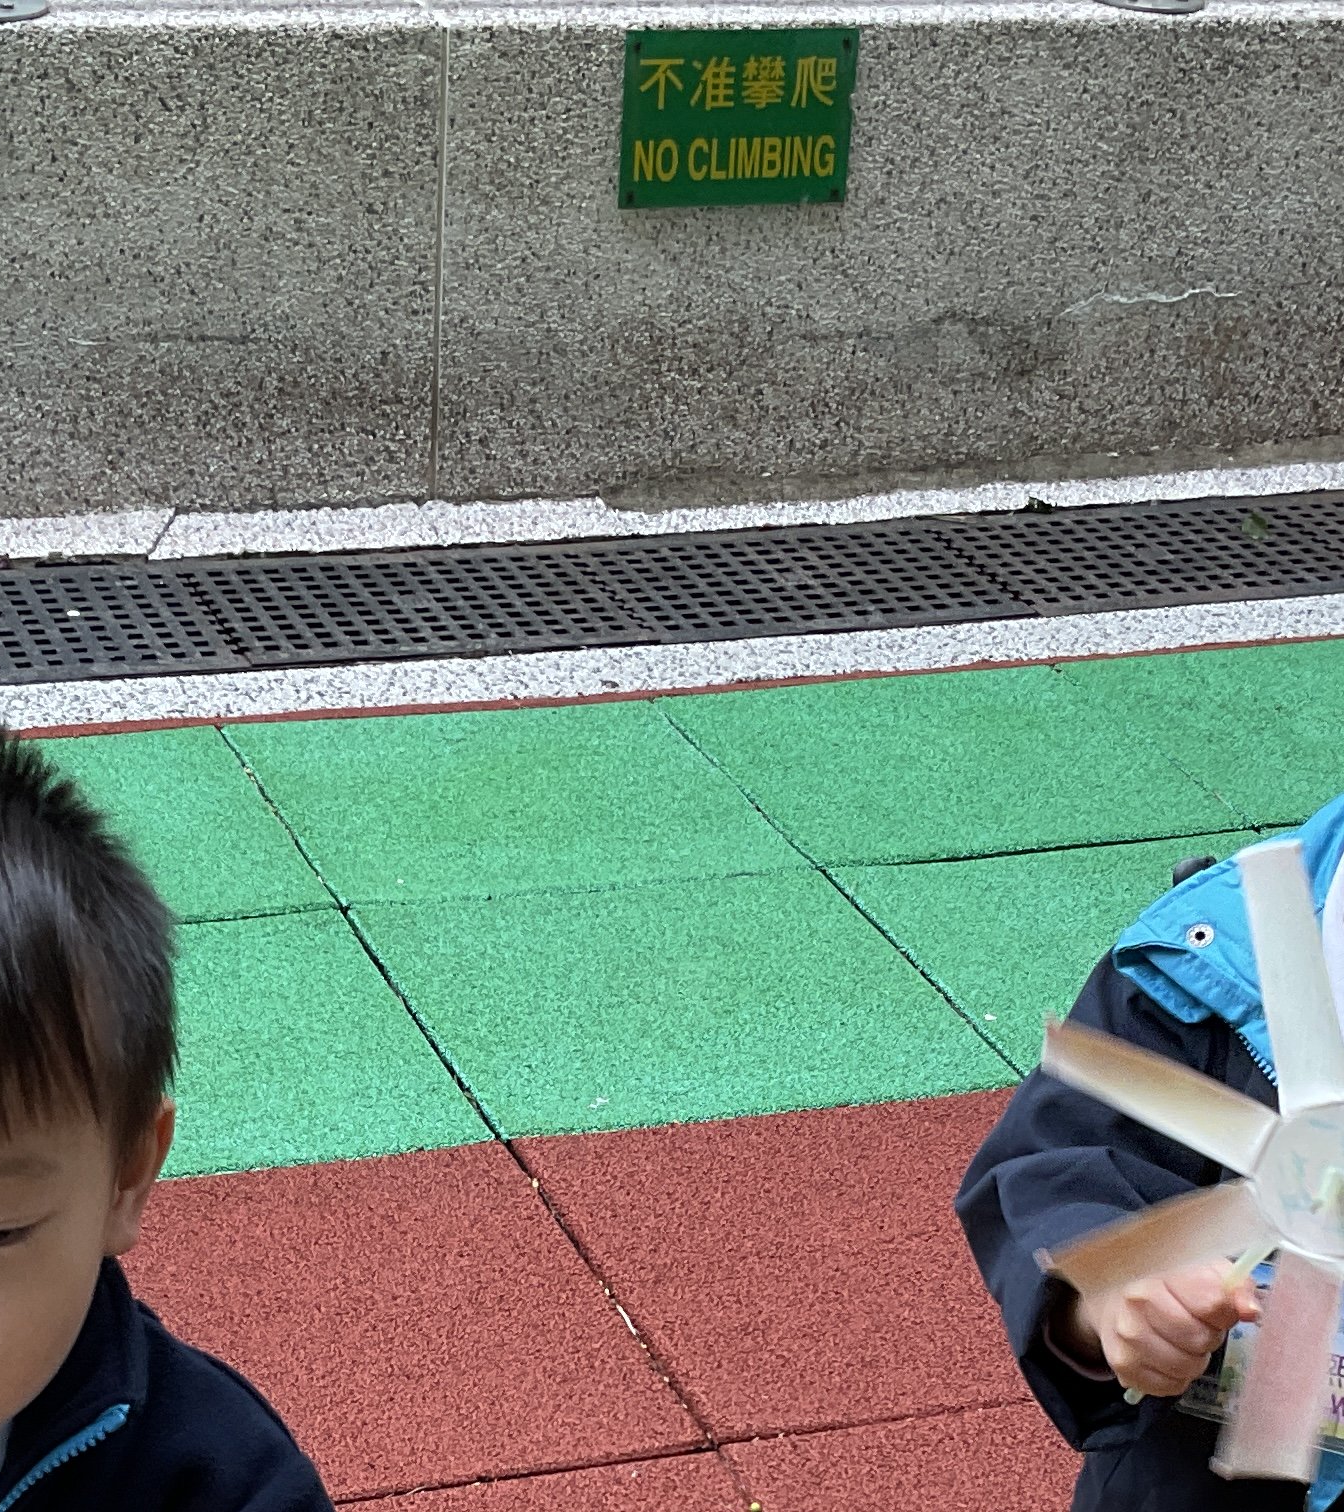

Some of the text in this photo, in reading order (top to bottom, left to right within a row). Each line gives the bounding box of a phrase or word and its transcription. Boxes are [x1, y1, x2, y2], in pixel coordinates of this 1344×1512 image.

[639, 55, 837, 111] 不准攀爬
[632, 135, 836, 182] NO CLIMBING
